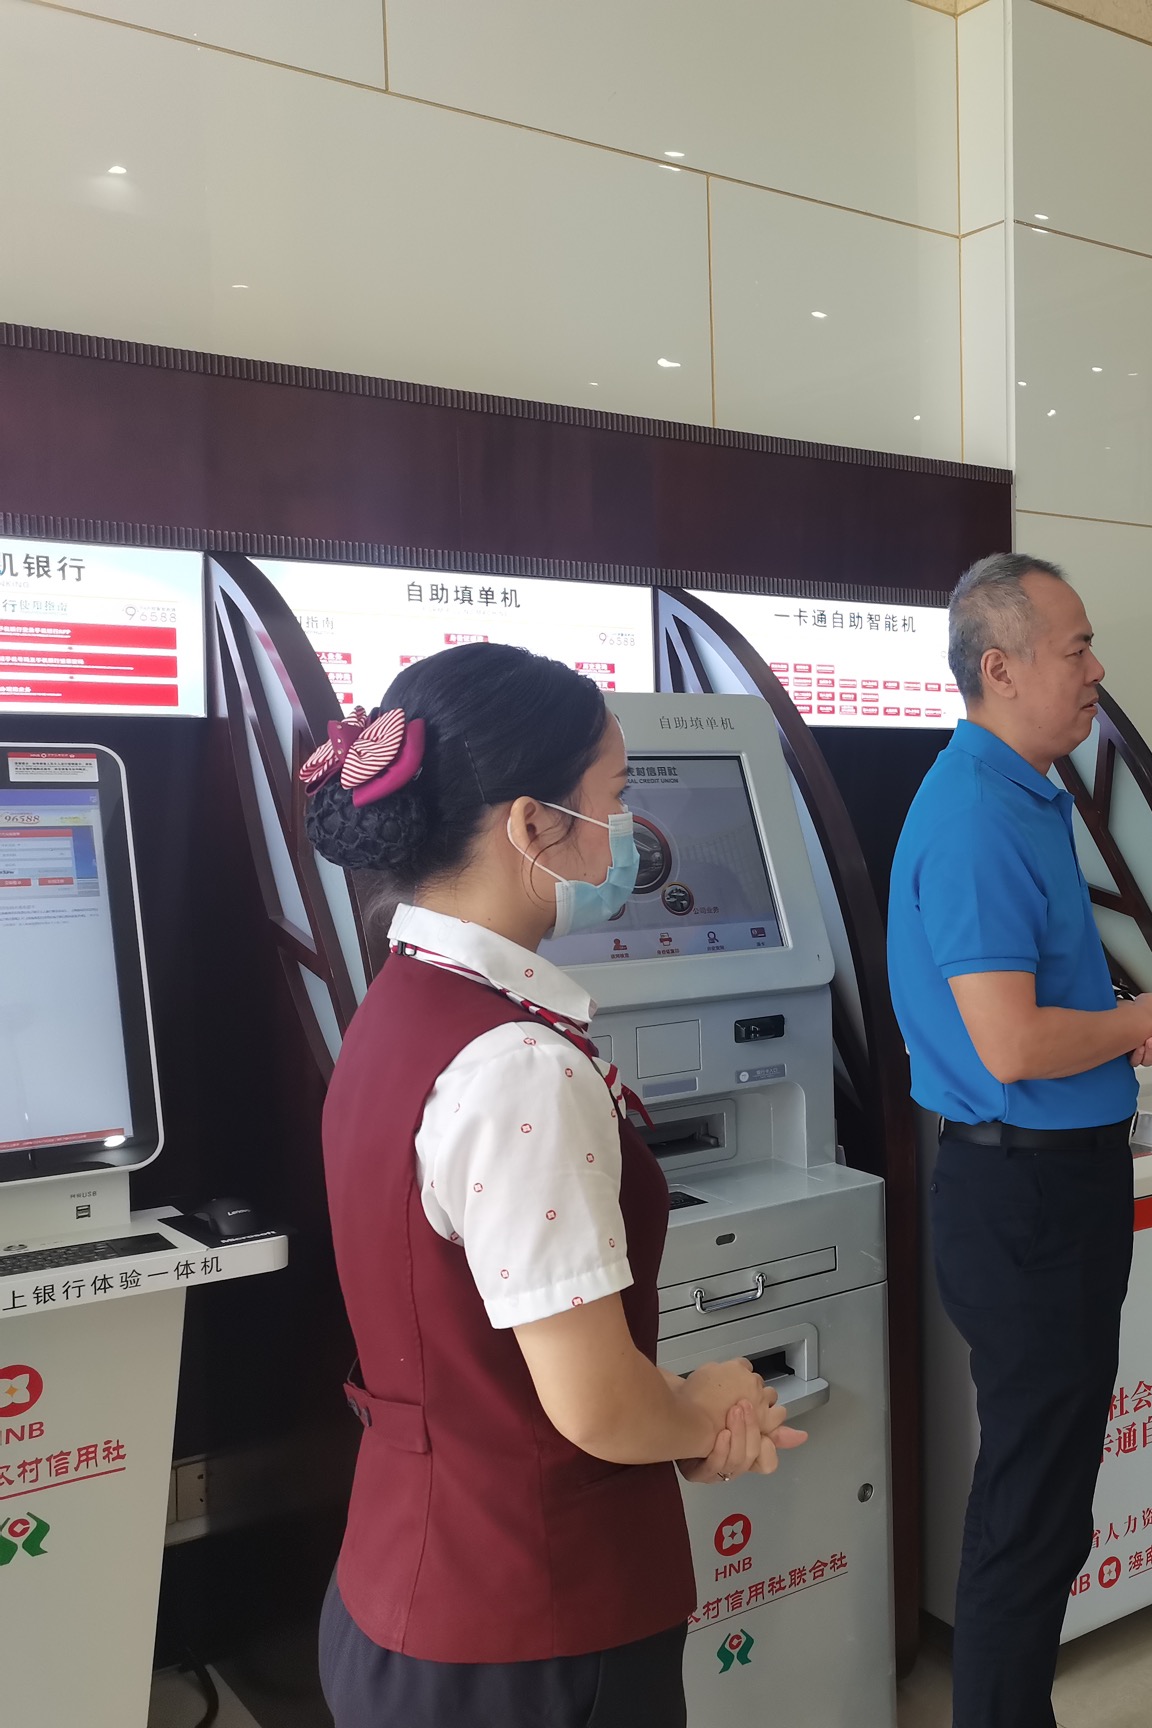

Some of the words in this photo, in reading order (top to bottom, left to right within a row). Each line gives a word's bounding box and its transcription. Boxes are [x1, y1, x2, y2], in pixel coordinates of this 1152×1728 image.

[407, 581, 521, 608] 自助填单机
[125, 606, 177, 623] 96588
[299, 615, 334, 630] 指南
[774, 608, 916, 632] 一卡通自助智能机
[598, 632, 636, 646] 96588
[658, 715, 735, 731] 自助填单机
[4, 814, 40, 823] 96588
[2, 1254, 223, 1311] 上银行体验一体机
[0, 1421, 45, 1445] NB
[714, 1556, 753, 1582] HNB
